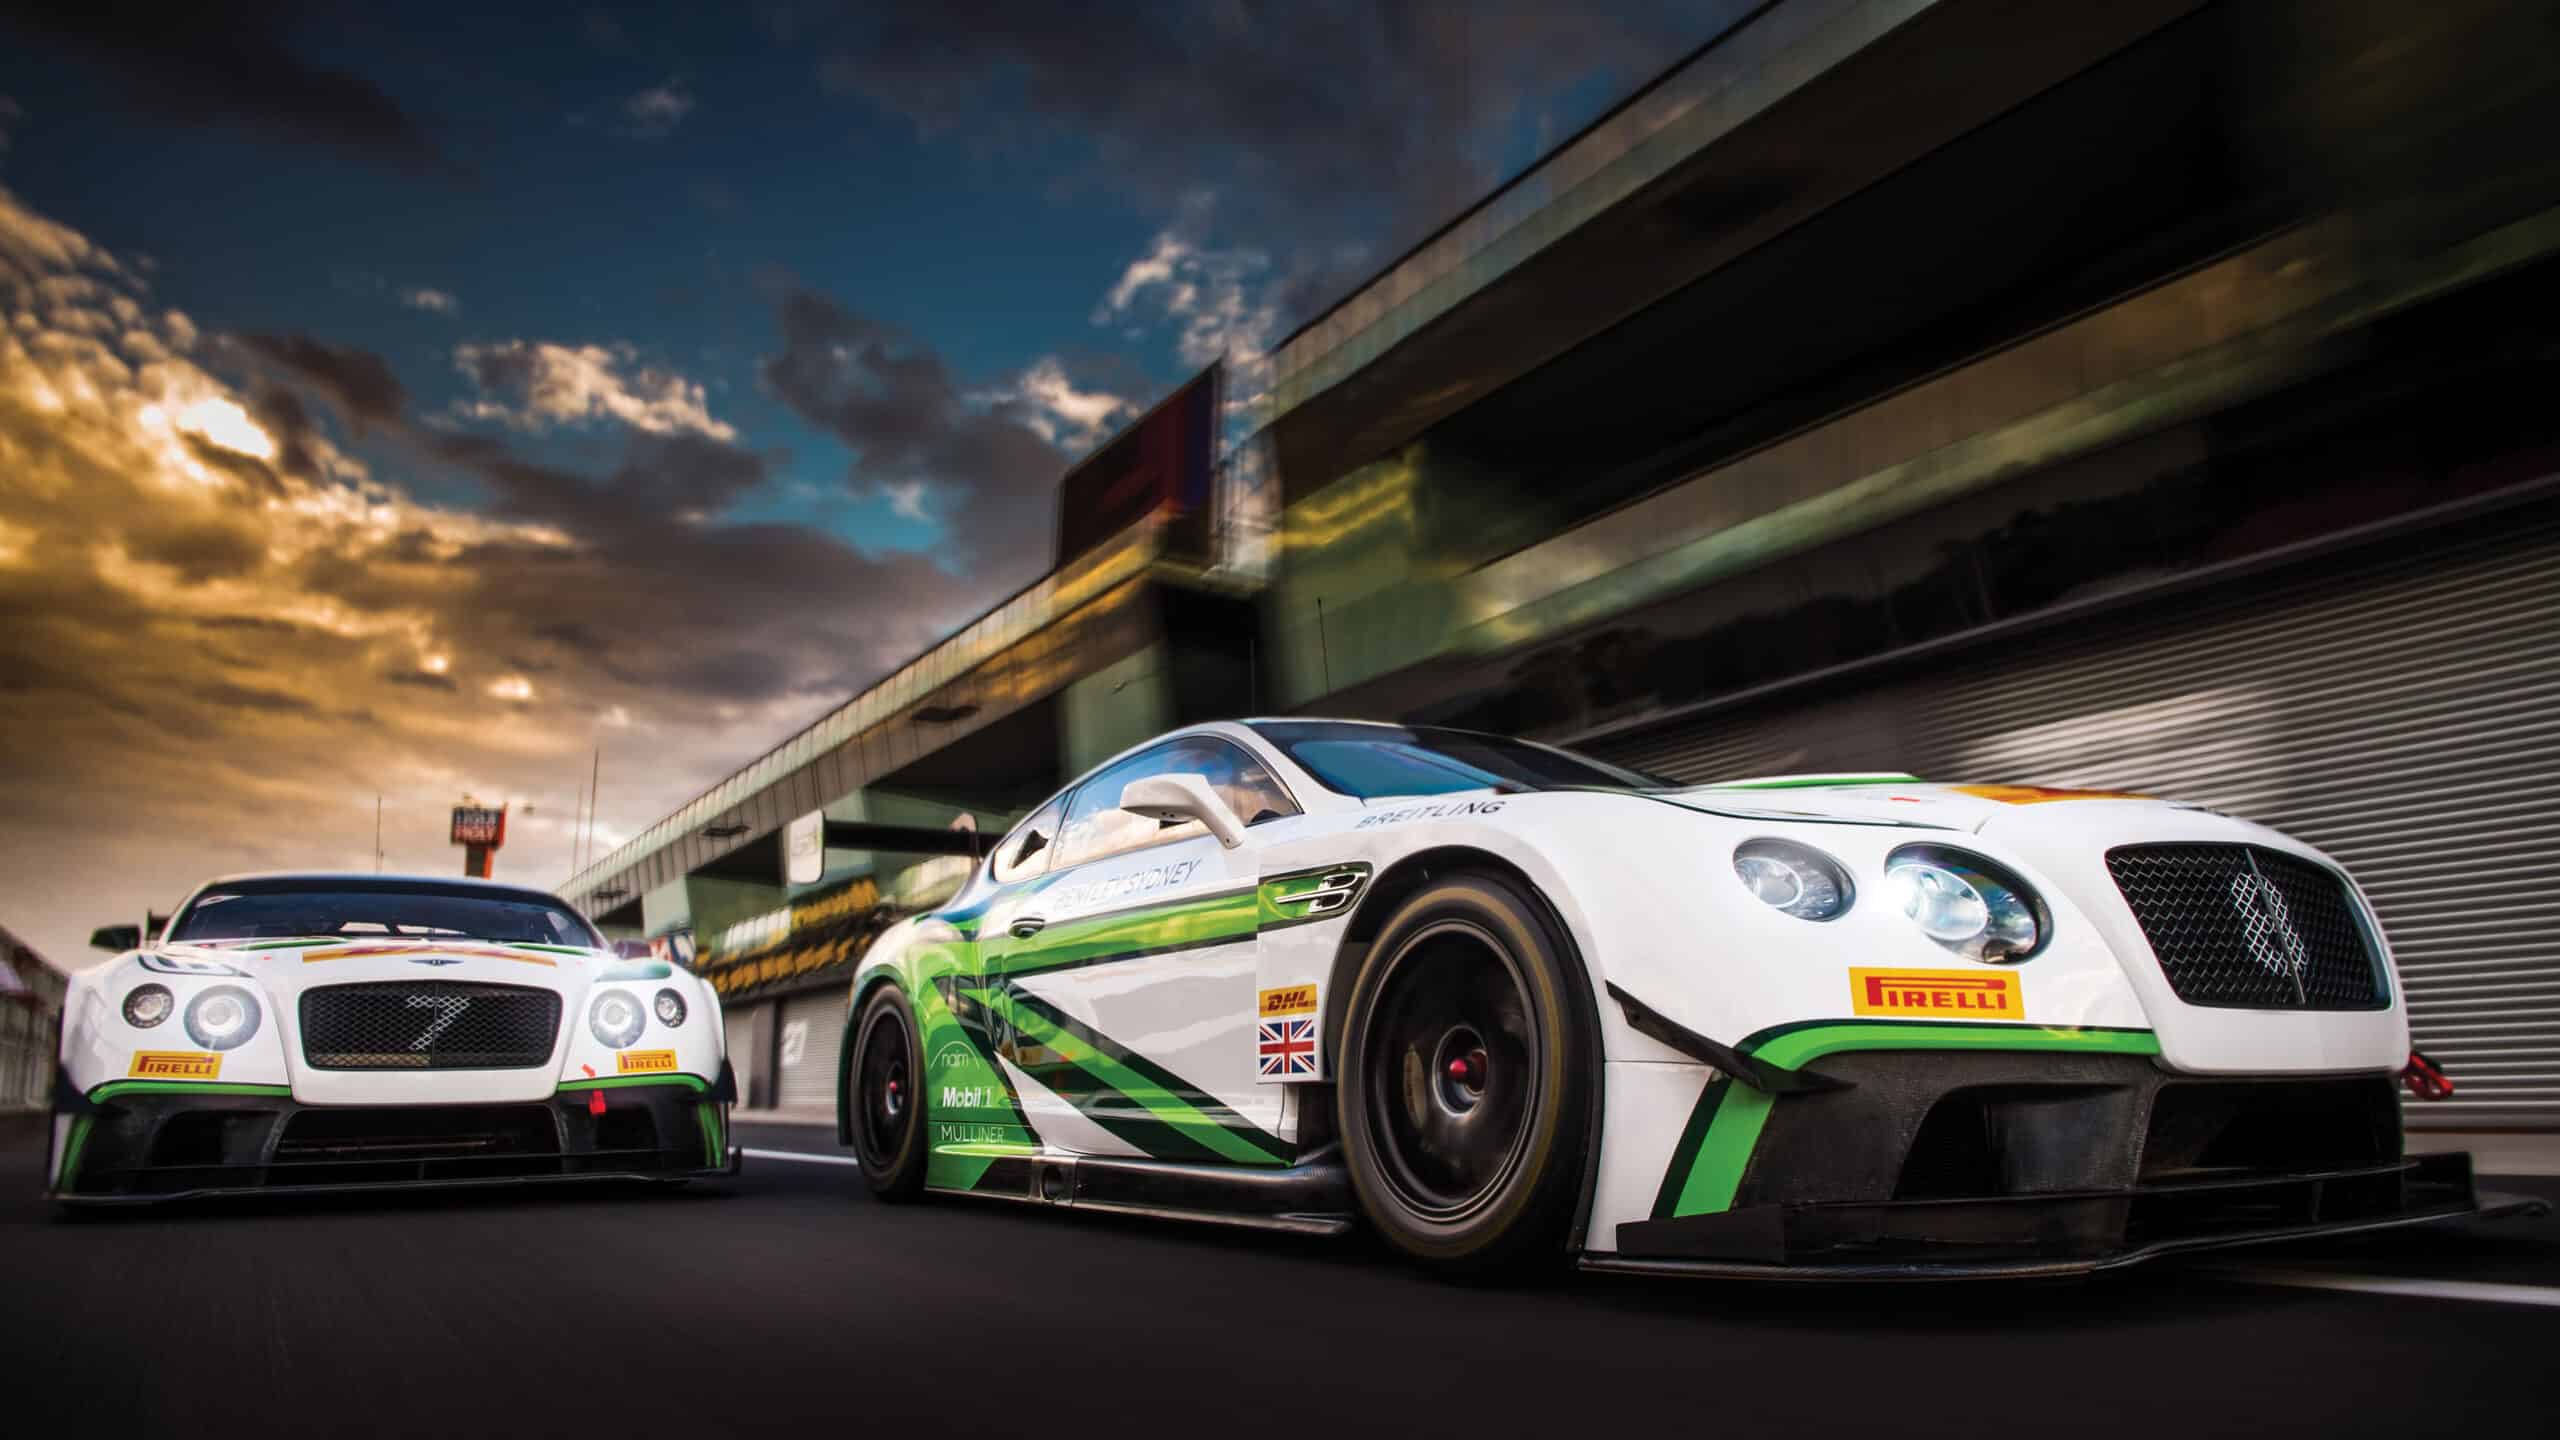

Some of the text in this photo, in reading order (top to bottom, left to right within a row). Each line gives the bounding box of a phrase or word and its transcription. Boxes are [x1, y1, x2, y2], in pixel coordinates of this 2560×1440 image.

[1354, 801, 1507, 830] BREITLING
[1123, 857, 1203, 896] SYDNEY
[1267, 989, 1310, 1012] DHL
[1865, 976, 2008, 1010] PIRELLI
[405, 994, 471, 1051] 7
[137, 1055, 215, 1075] PIRELLI
[622, 1053, 673, 1070] PIRELLI
[942, 1086, 981, 1108] Mobil
[940, 1124, 1004, 1144] MULLINER
